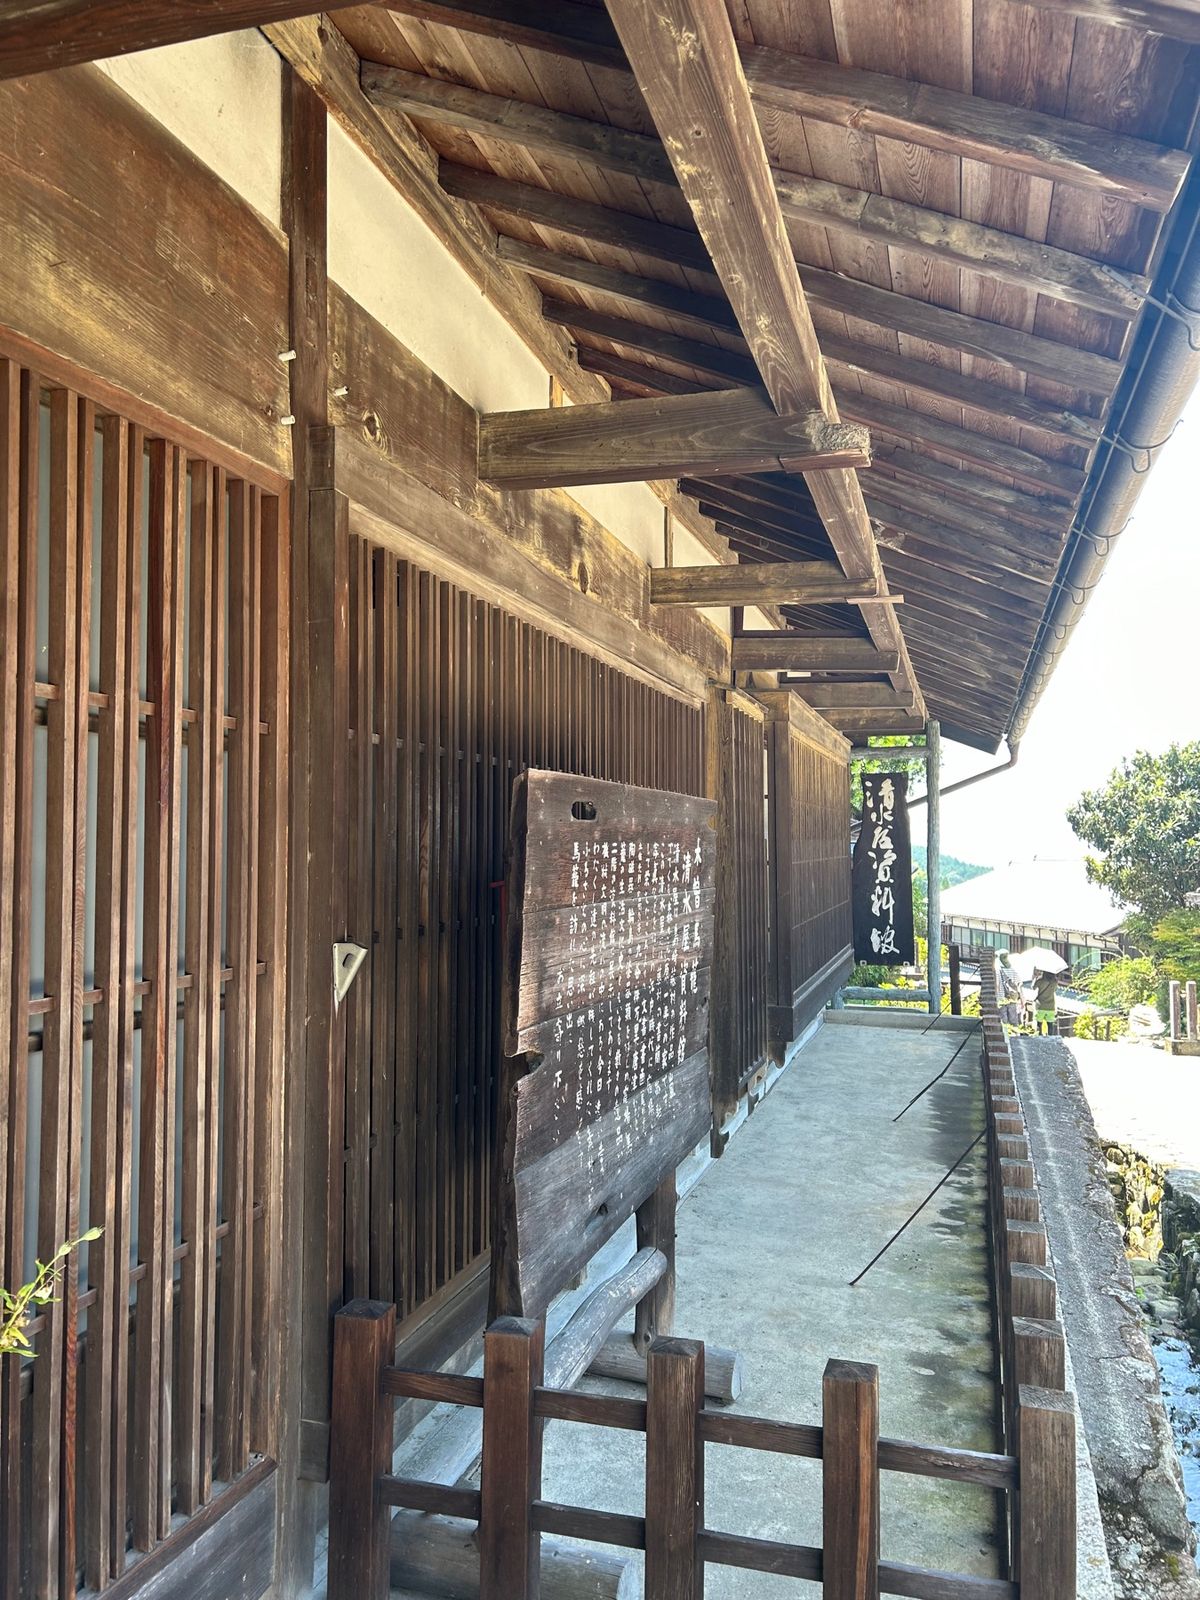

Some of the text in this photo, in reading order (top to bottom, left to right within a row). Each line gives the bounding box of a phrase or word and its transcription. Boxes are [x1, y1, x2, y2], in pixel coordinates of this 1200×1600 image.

[677, 851, 691, 1064] 清水屋資料館
